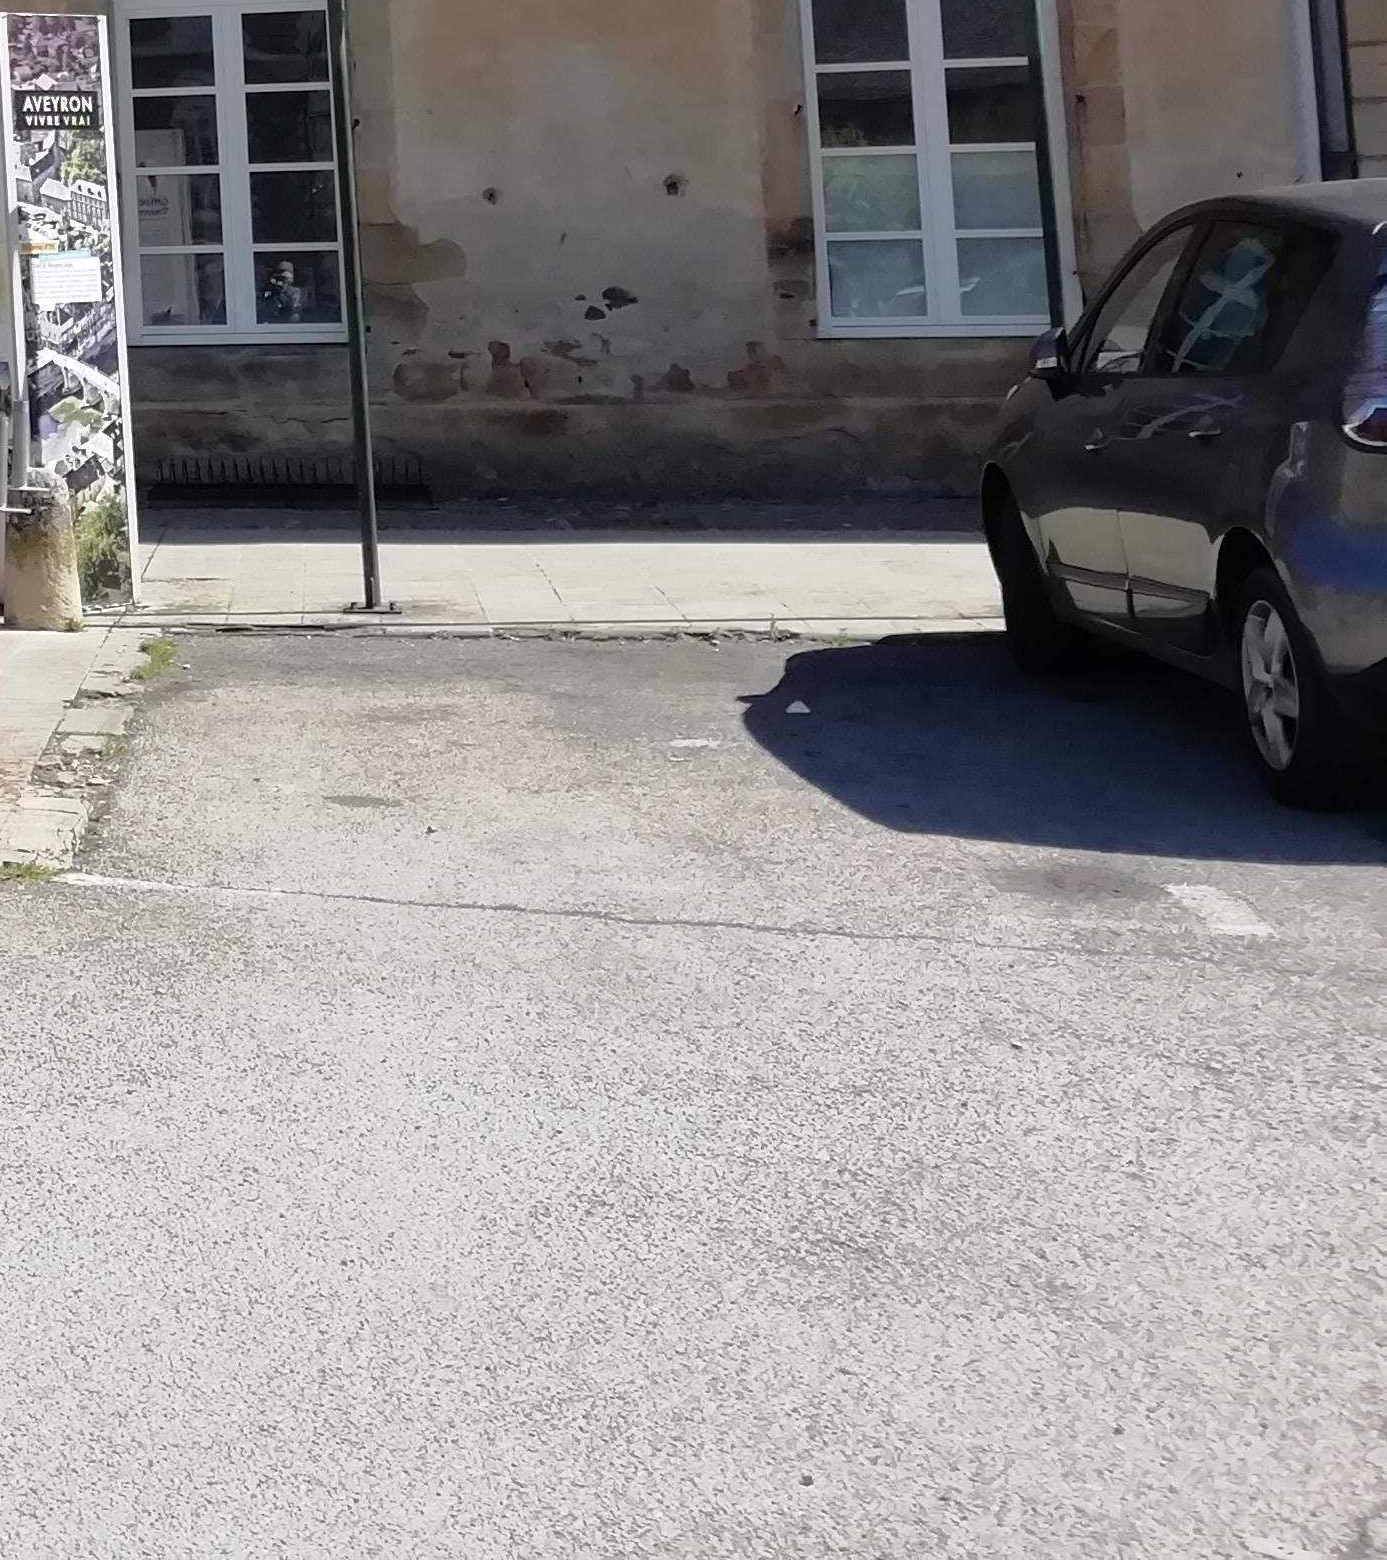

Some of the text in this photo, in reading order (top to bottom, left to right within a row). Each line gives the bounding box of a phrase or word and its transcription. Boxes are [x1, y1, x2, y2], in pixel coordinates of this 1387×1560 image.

[22, 95, 94, 113] AVEYRON
[25, 115, 91, 127] VIVRE VRAI
